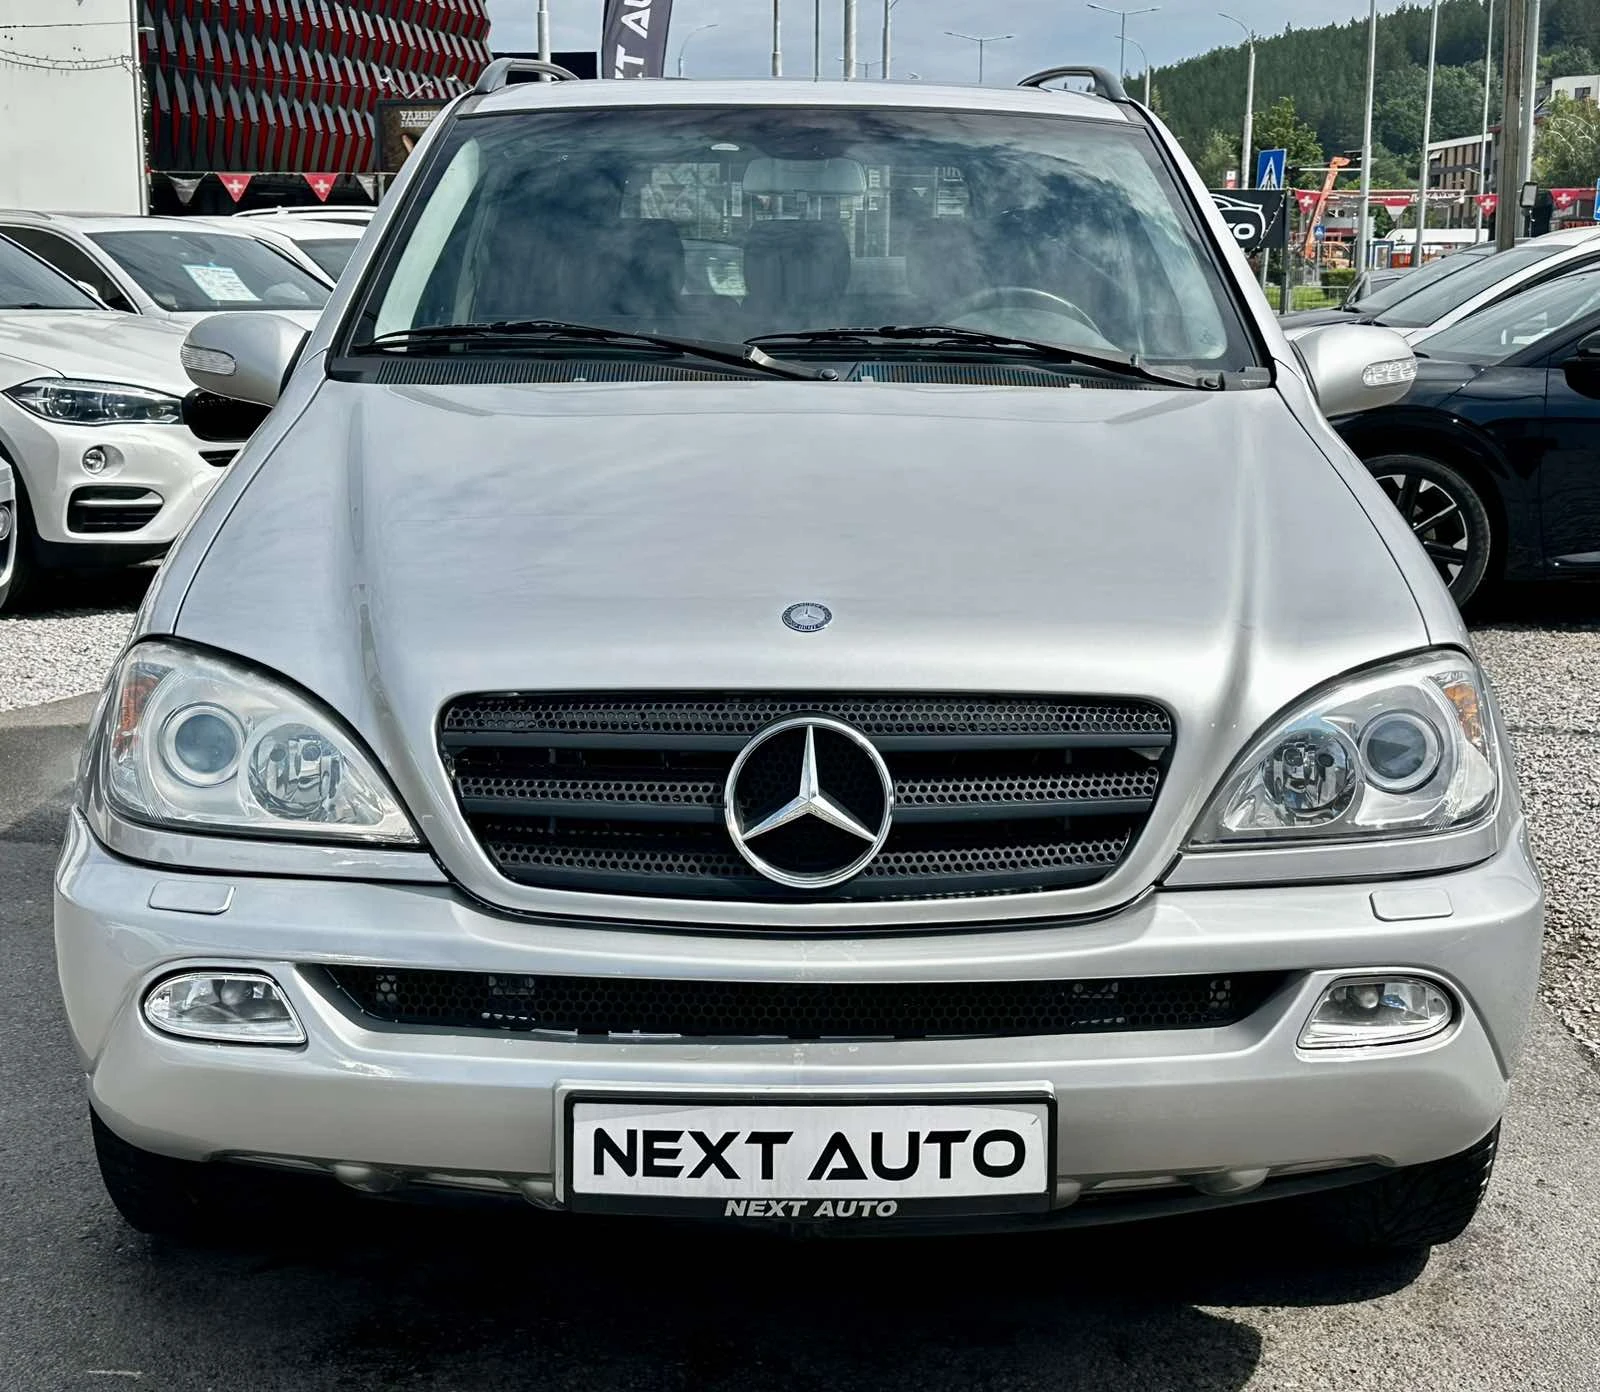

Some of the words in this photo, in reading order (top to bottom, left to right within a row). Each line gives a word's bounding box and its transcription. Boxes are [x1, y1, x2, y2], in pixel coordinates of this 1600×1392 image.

[593, 1127, 794, 1181] NEXT
[807, 1128, 1027, 1181] AUTO
[724, 1200, 807, 1218] NEXT
[814, 1200, 898, 1218] AUTO
